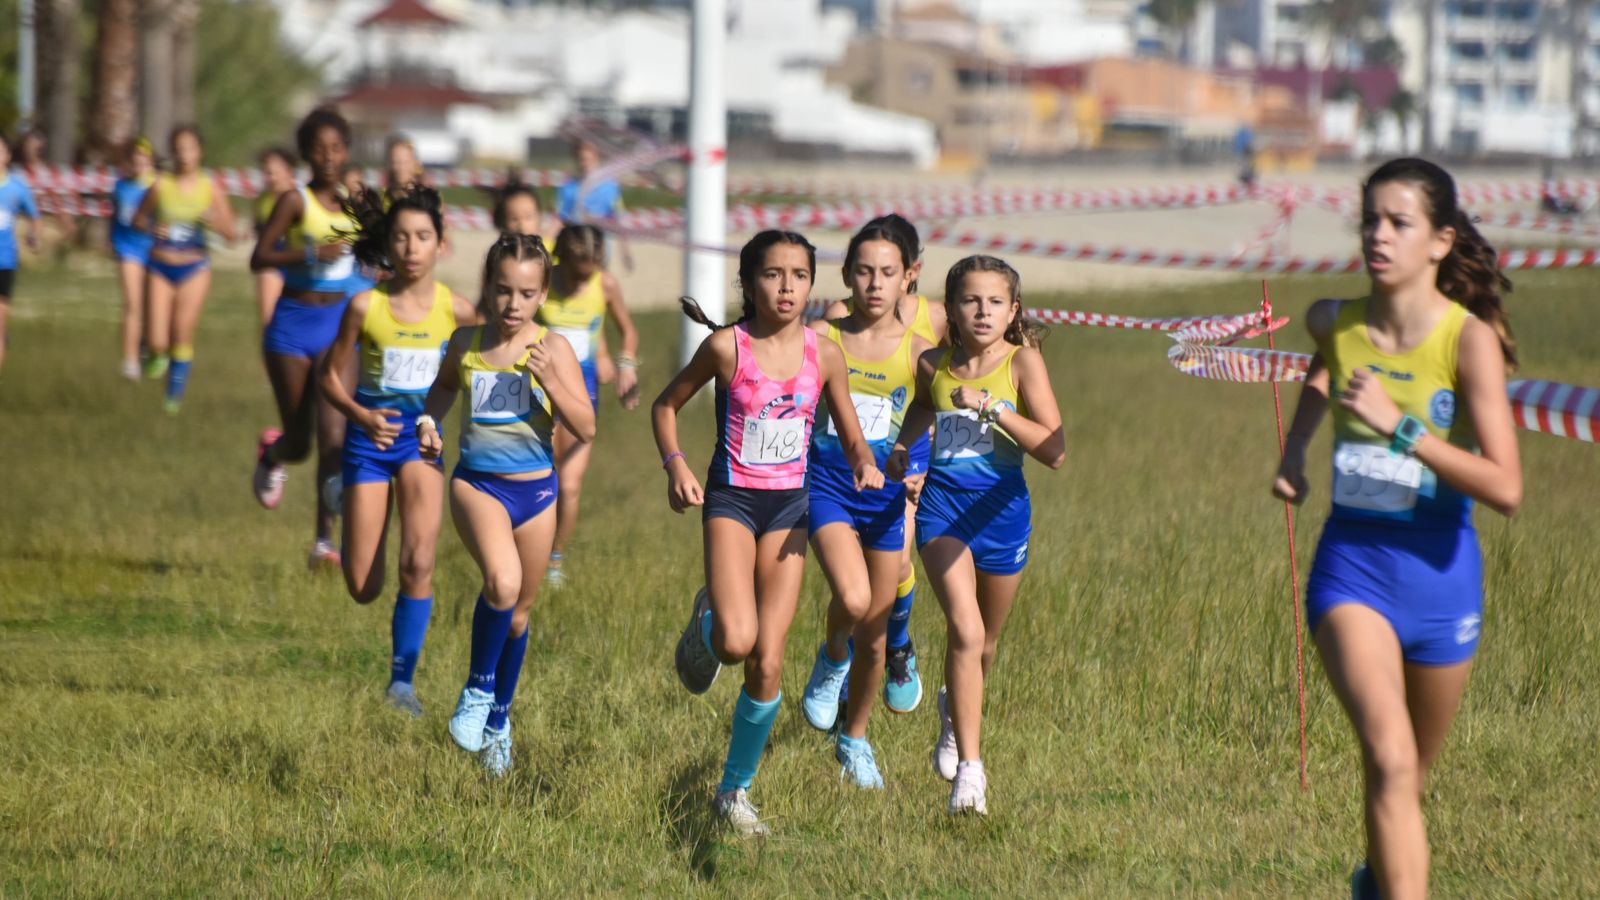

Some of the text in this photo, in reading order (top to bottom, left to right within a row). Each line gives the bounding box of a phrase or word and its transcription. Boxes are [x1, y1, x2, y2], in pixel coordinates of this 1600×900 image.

[388, 353, 429, 383] 214
[474, 377, 523, 414] 269
[760, 430, 798, 460] 148
